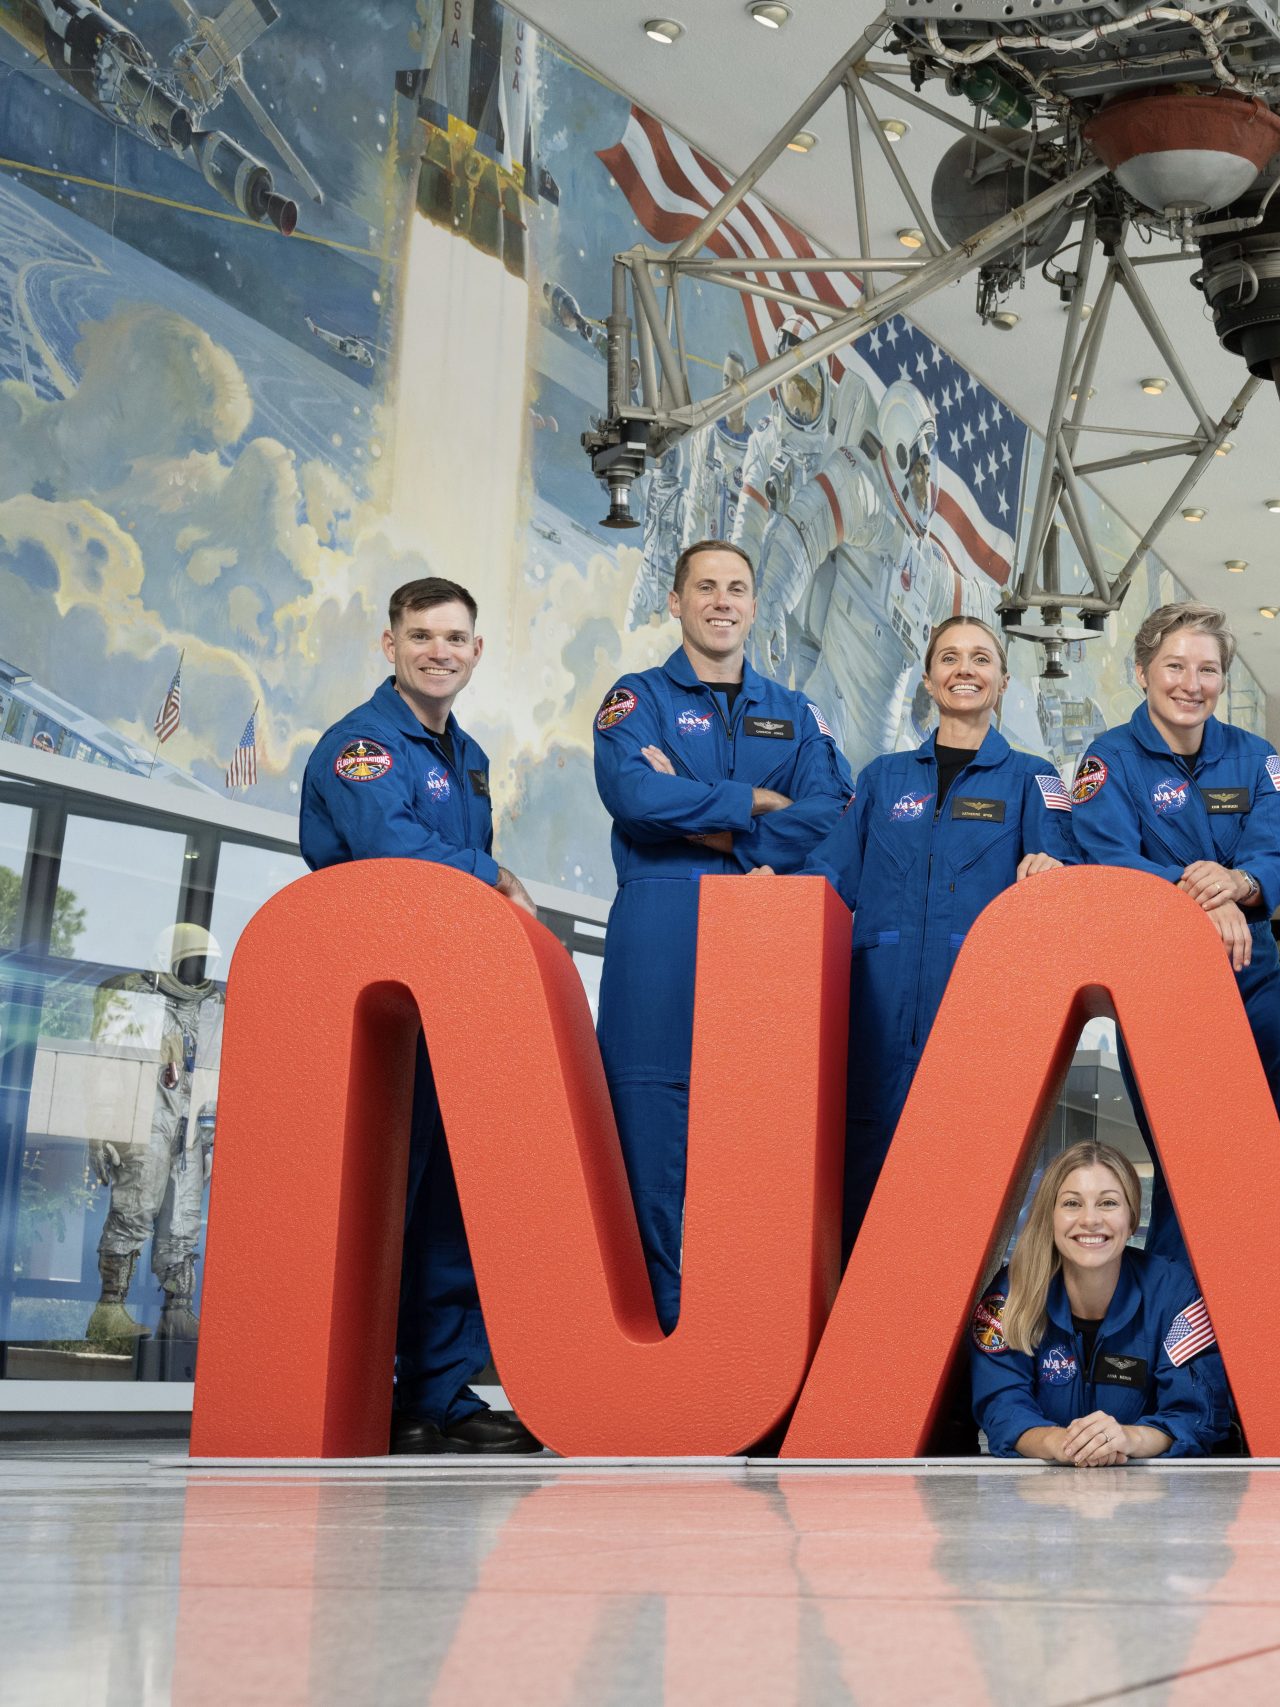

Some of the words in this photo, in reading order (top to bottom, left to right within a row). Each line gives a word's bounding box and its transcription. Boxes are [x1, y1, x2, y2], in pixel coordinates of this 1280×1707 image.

[512, 21, 524, 94] USA
[677, 717, 710, 725] NASA
[427, 779, 450, 790] NASA
[1153, 790, 1186, 801] NASA
[893, 802, 923, 810] NASA
[1043, 1359, 1077, 1369] NASA
